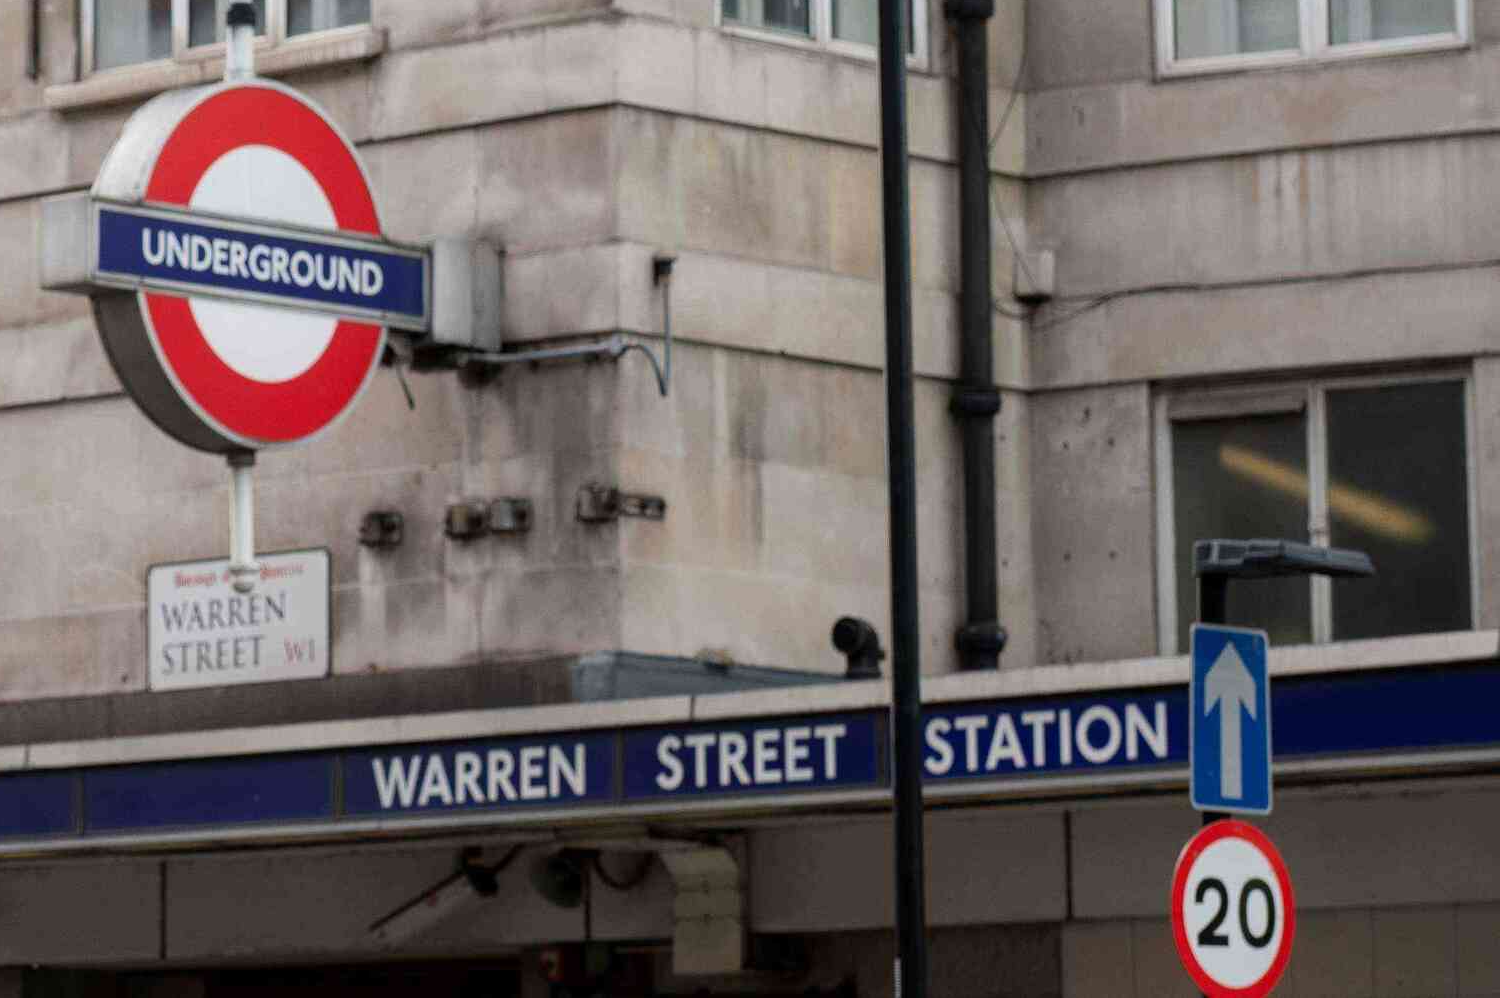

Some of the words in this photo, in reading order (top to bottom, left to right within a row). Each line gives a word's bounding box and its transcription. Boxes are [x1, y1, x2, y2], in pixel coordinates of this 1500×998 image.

[141, 228, 384, 296] UNDERGROUND
[161, 590, 287, 632] WARREN
[162, 635, 265, 675] STREET
[372, 743, 587, 808] WARREN
[655, 724, 847, 791] STREET
[924, 701, 1169, 775] STATION
[1194, 878, 1277, 948] 20
